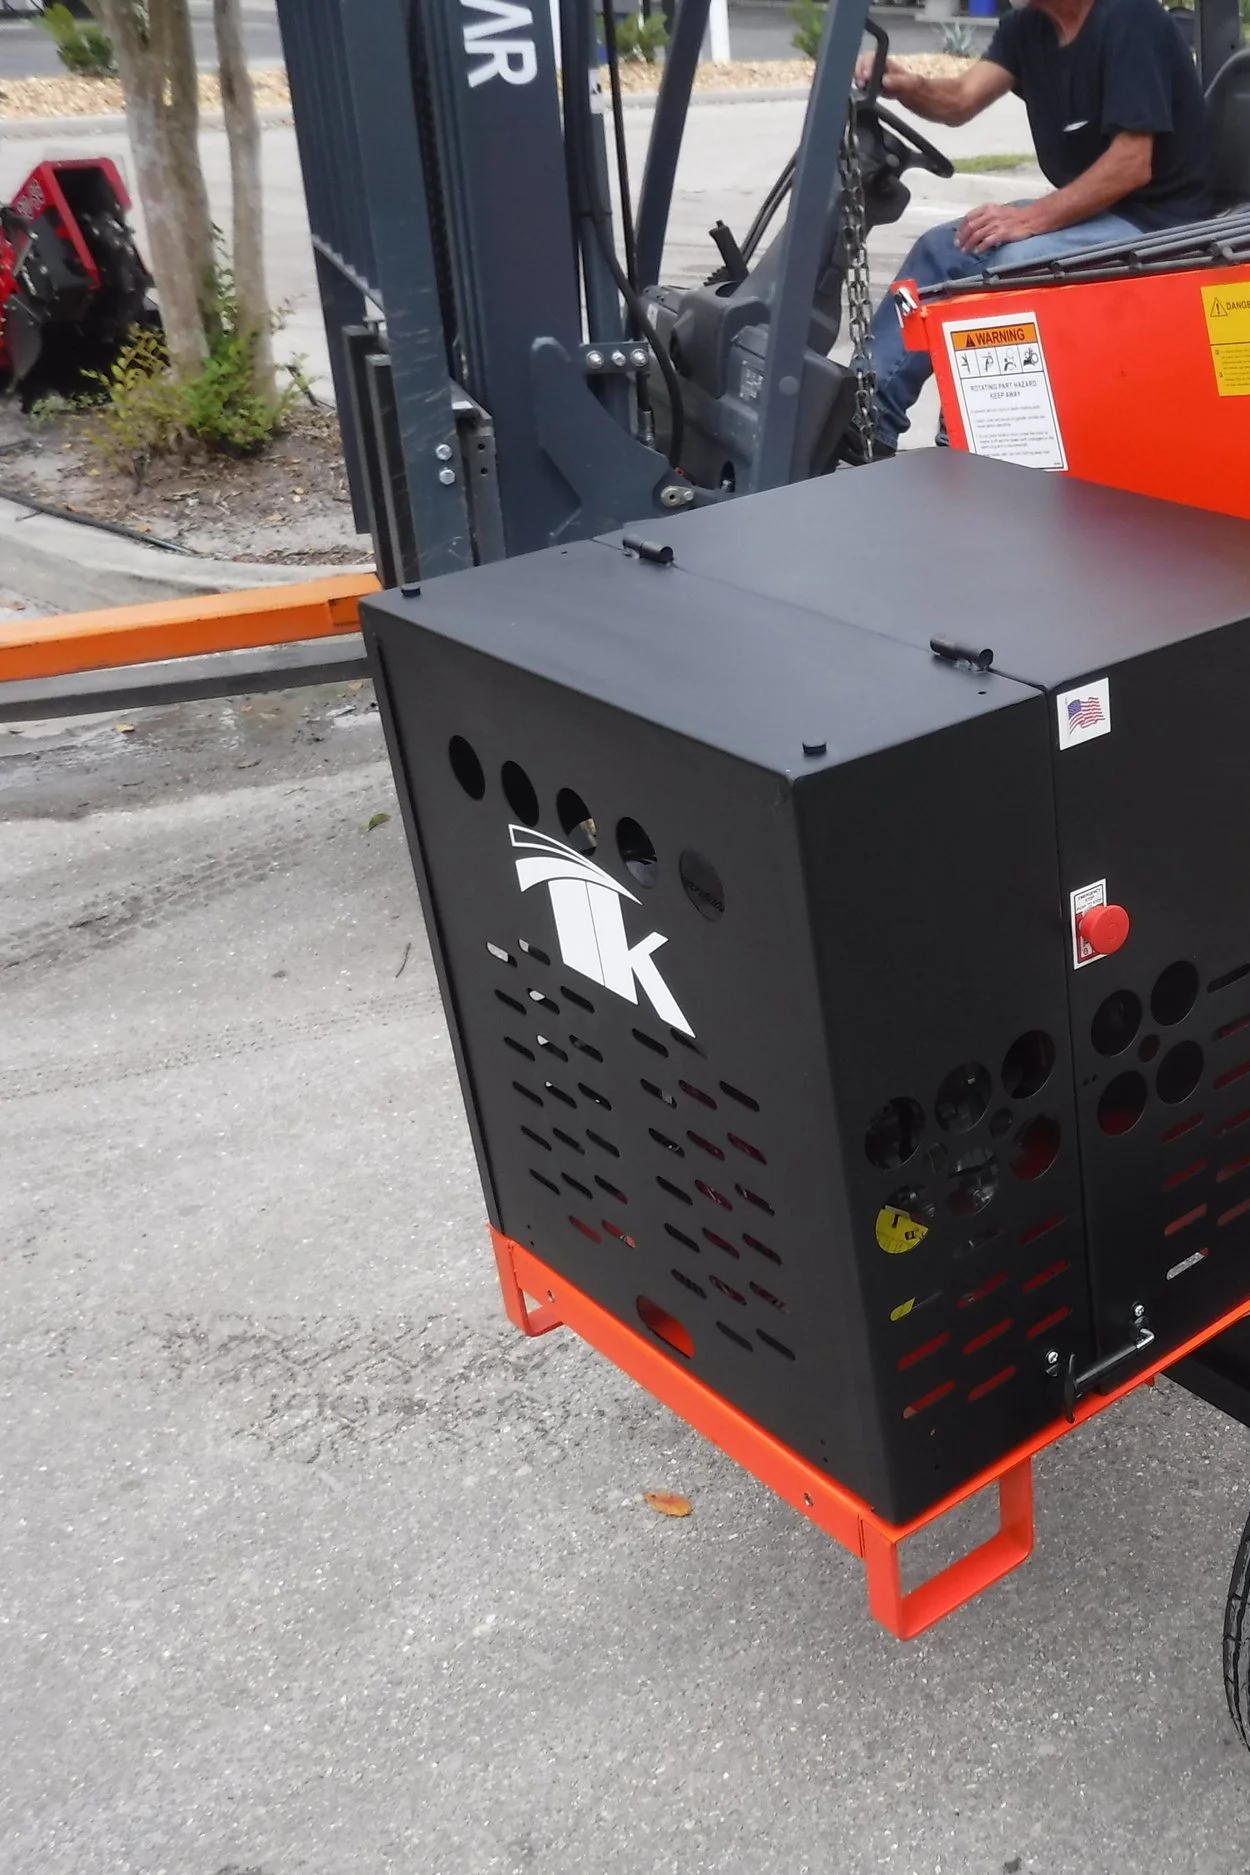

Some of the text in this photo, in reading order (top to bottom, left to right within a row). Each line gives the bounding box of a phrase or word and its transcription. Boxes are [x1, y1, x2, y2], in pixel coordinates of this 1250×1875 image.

[976, 328, 1025, 345] WARNING
[970, 384, 998, 392] ROTATING
[1013, 380, 1037, 388] HAZARD
